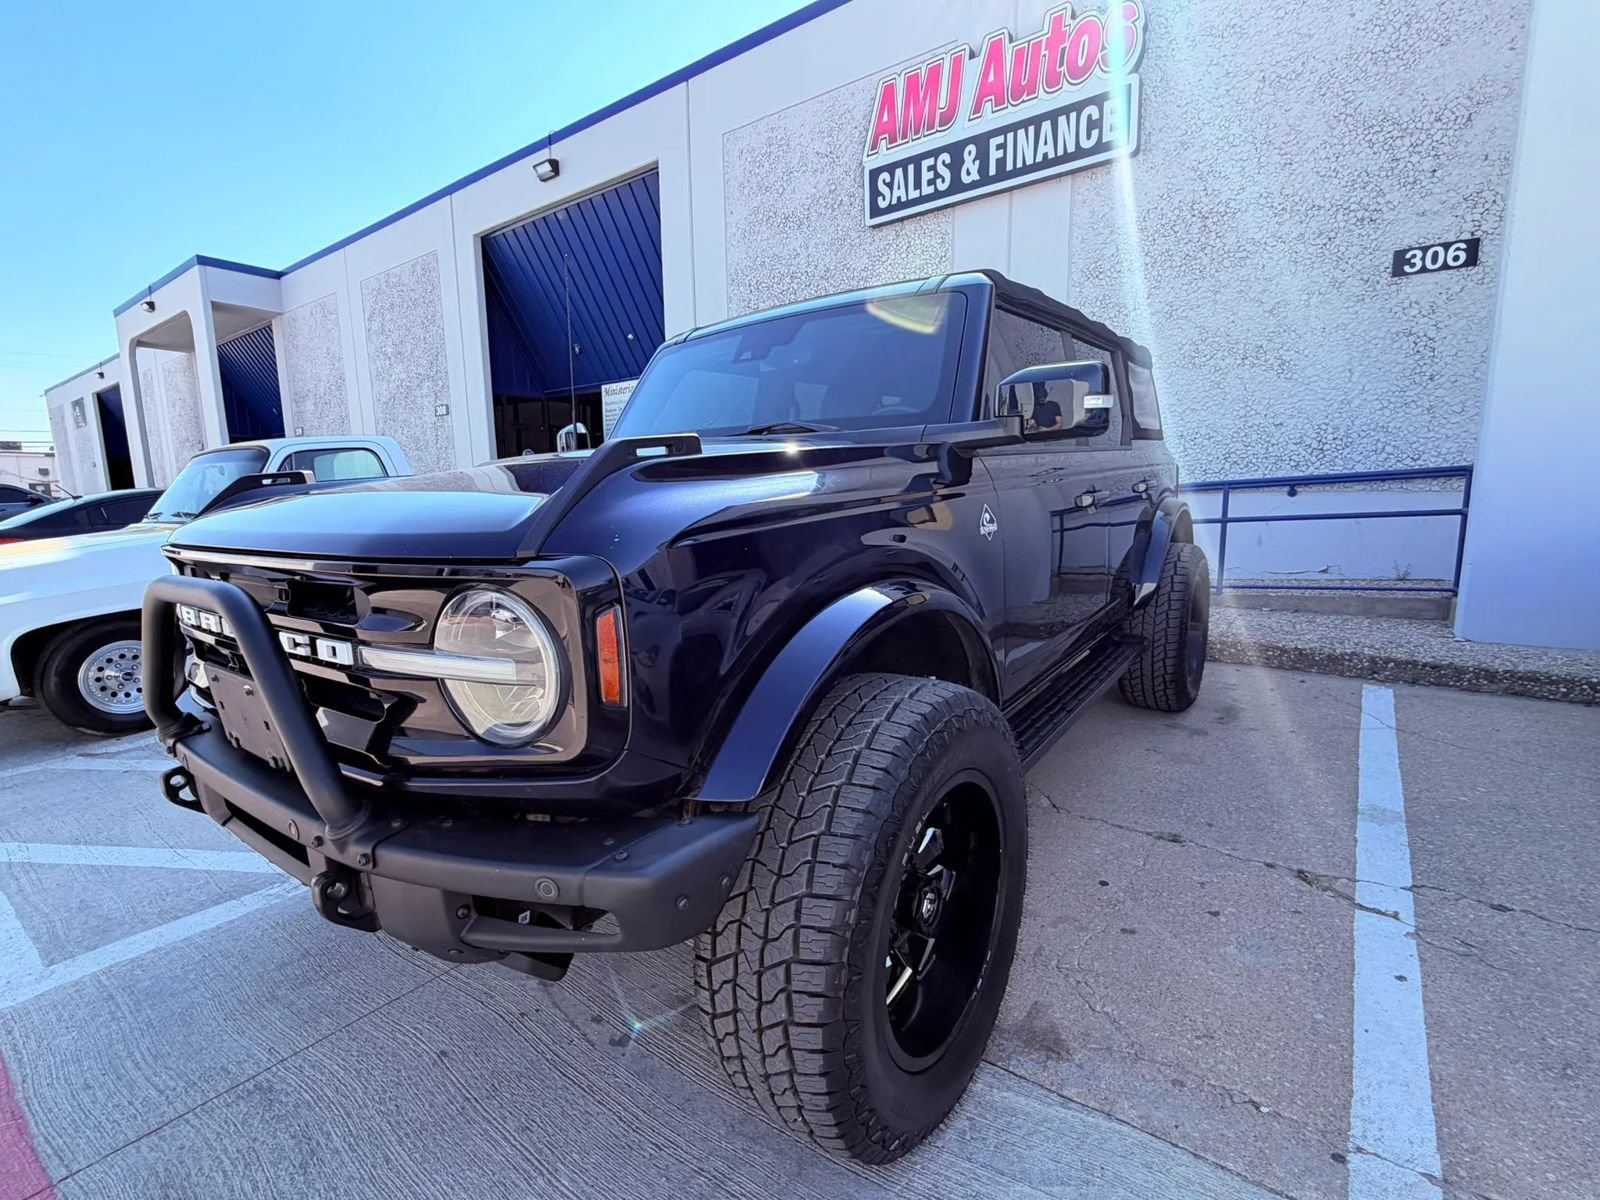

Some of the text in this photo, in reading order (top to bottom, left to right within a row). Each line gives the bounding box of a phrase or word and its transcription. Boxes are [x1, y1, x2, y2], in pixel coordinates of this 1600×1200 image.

[867, 2, 1139, 157] AMJ Autos
[876, 96, 1121, 210] SALES & FINANCE
[1403, 242, 1468, 273] 306
[179, 603, 354, 666] BRCO
